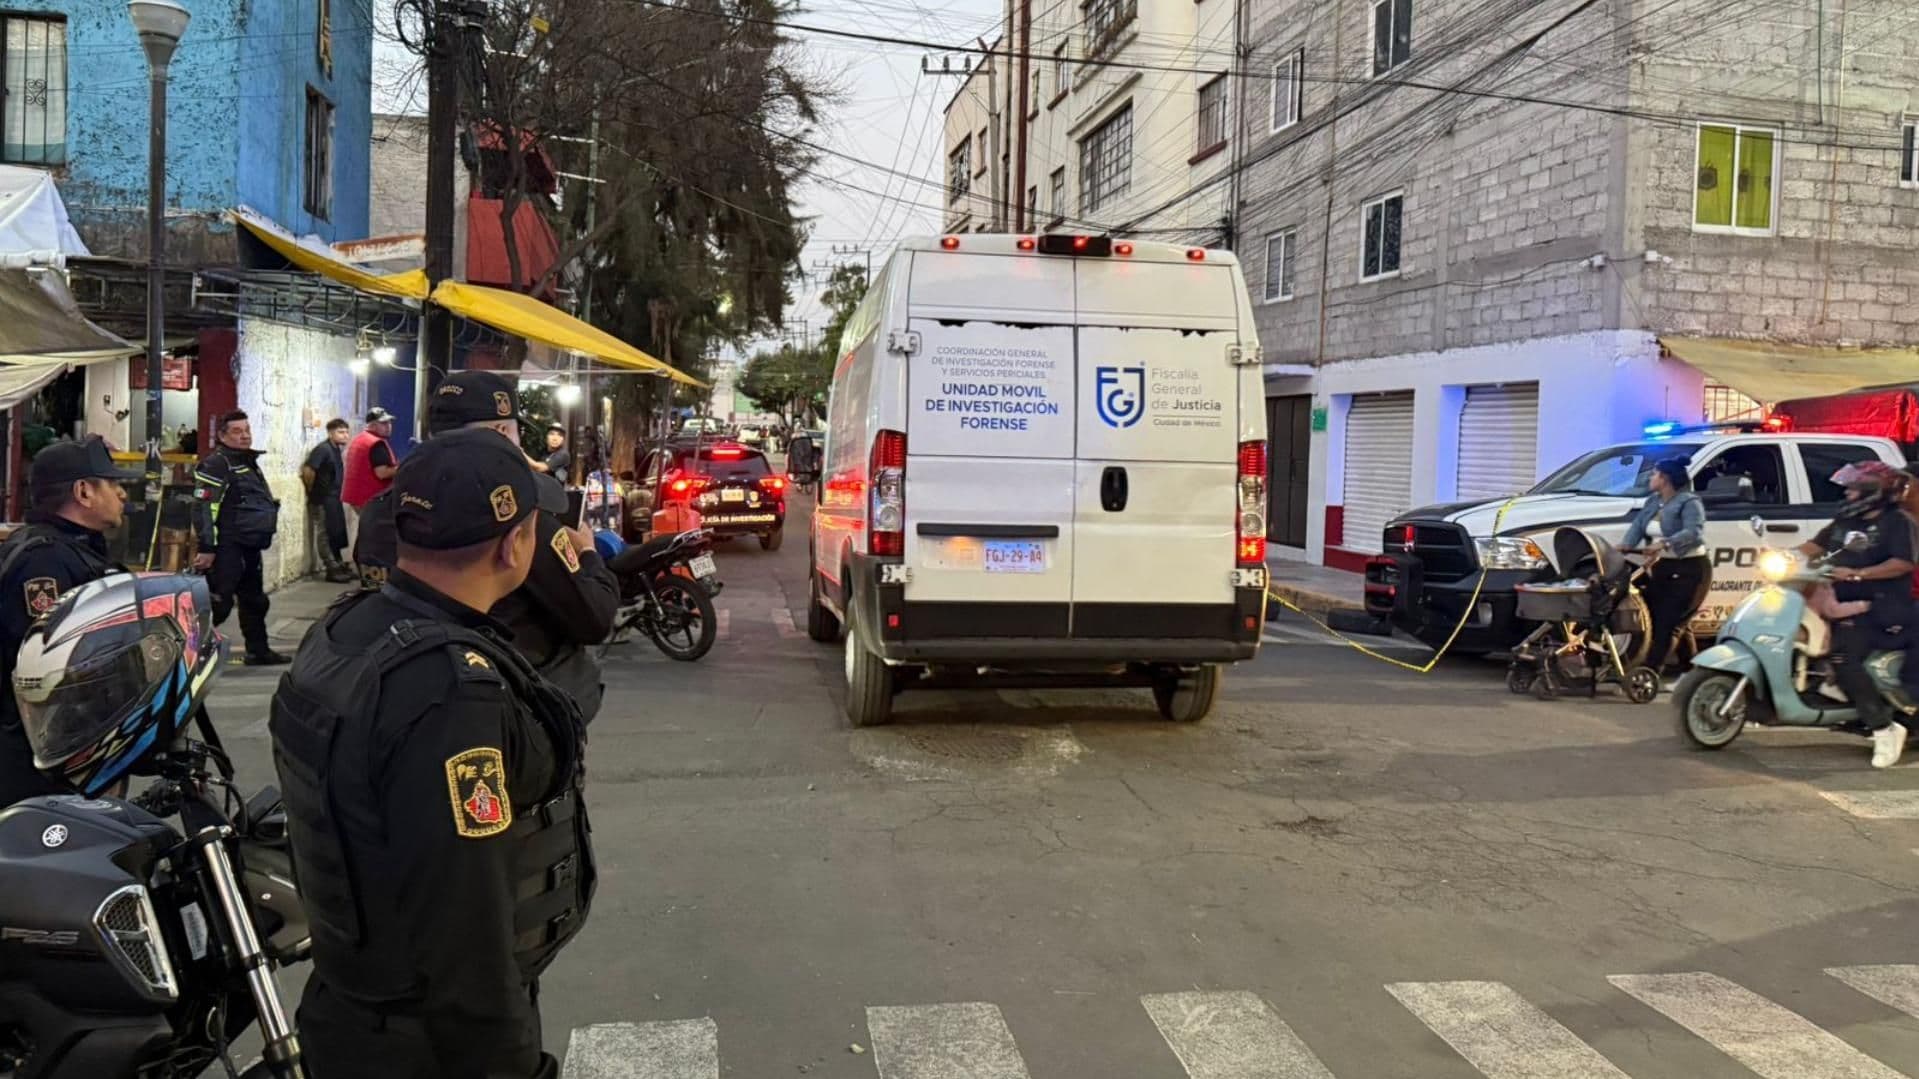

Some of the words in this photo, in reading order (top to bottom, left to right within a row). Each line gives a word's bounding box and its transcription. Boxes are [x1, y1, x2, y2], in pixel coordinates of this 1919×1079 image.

[1008, 349, 1048, 358] GENERAL
[932, 357, 944, 365] DE
[946, 357, 1013, 367] INVESTIGACIÓN
[1015, 360, 1055, 369] FORENSE
[941, 368, 947, 376] Y
[950, 368, 995, 378] SERVICIOS
[997, 370, 1046, 379] PERICIALES
[942, 383, 998, 396] UNIDAD
[1002, 385, 1047, 398] MOVIL
[1152, 383, 1201, 395] General
[925, 399, 944, 411] DE
[948, 400, 1058, 414] INVESTIGACIÓN
[1152, 400, 1168, 409] de
[1172, 400, 1221, 411] Justicia
[961, 417, 1027, 430] FORENSE
[1153, 418, 1180, 426] Ciudad
[1182, 418, 1192, 426] de
[1711, 580, 1752, 591] CUADRANTE
